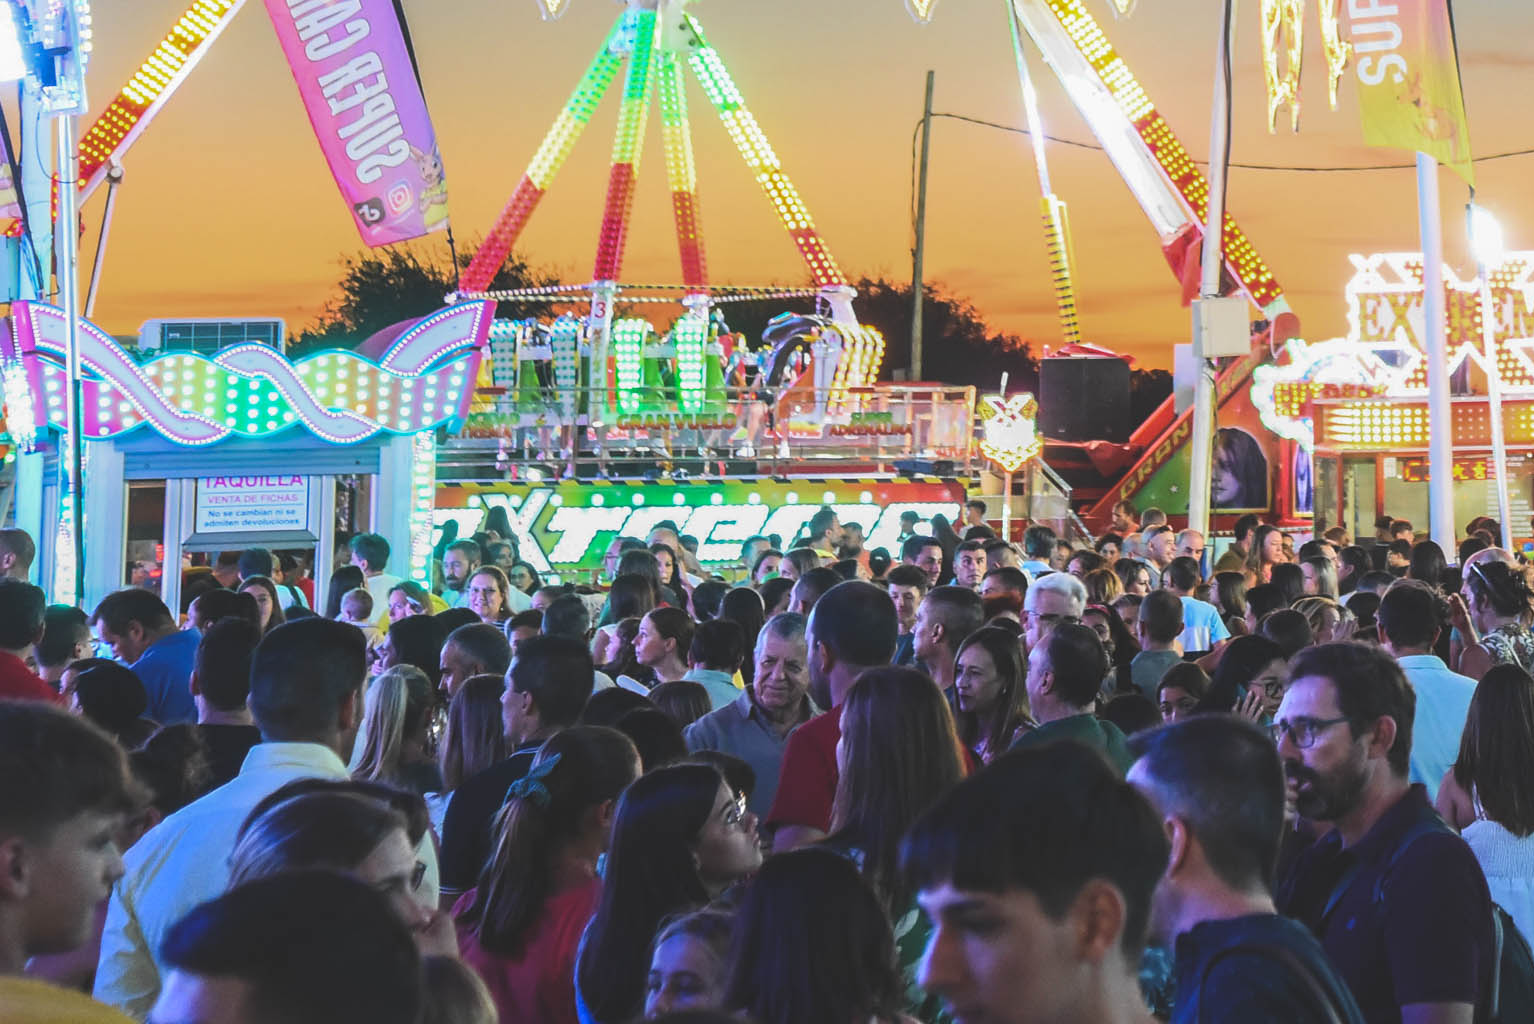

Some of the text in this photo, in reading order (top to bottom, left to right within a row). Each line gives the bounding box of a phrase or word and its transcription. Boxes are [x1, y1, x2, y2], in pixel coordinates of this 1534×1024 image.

[595, 302, 606, 318] 3
[208, 494, 298, 504] VENTA DE FICHAS
[236, 509, 272, 517] cambian
